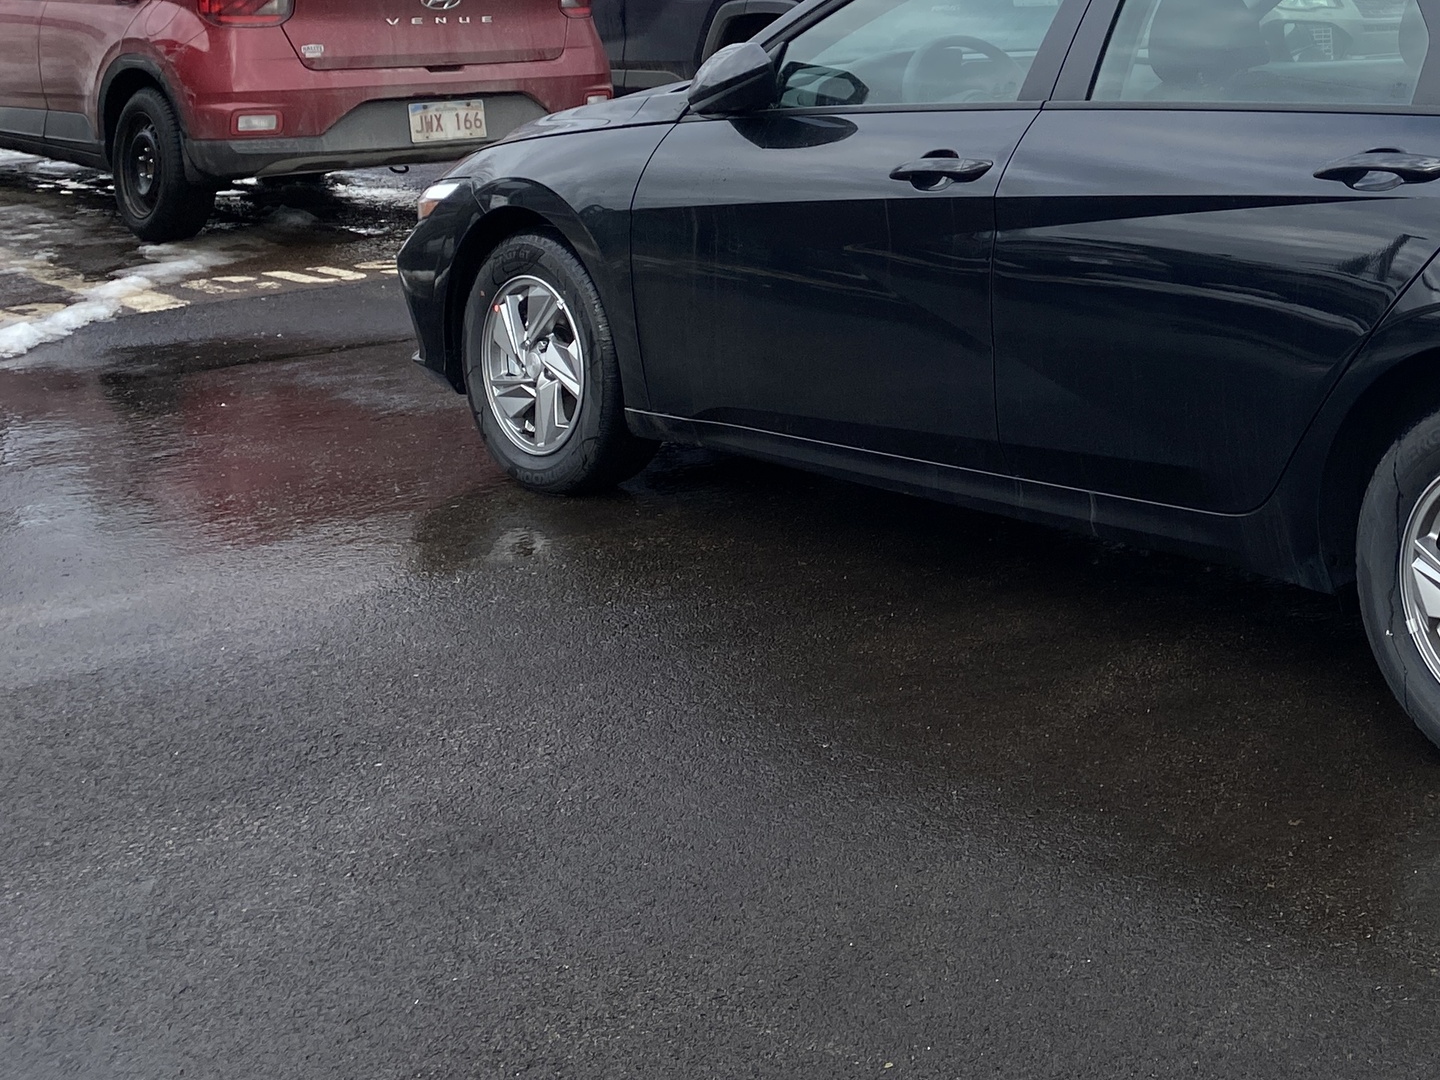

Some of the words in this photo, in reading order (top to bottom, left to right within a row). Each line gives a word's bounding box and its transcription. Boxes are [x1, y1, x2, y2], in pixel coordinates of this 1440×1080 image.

[386, 16, 493, 25] VENUE
[416, 113, 443, 133] JWX
[455, 111, 483, 131] 166
